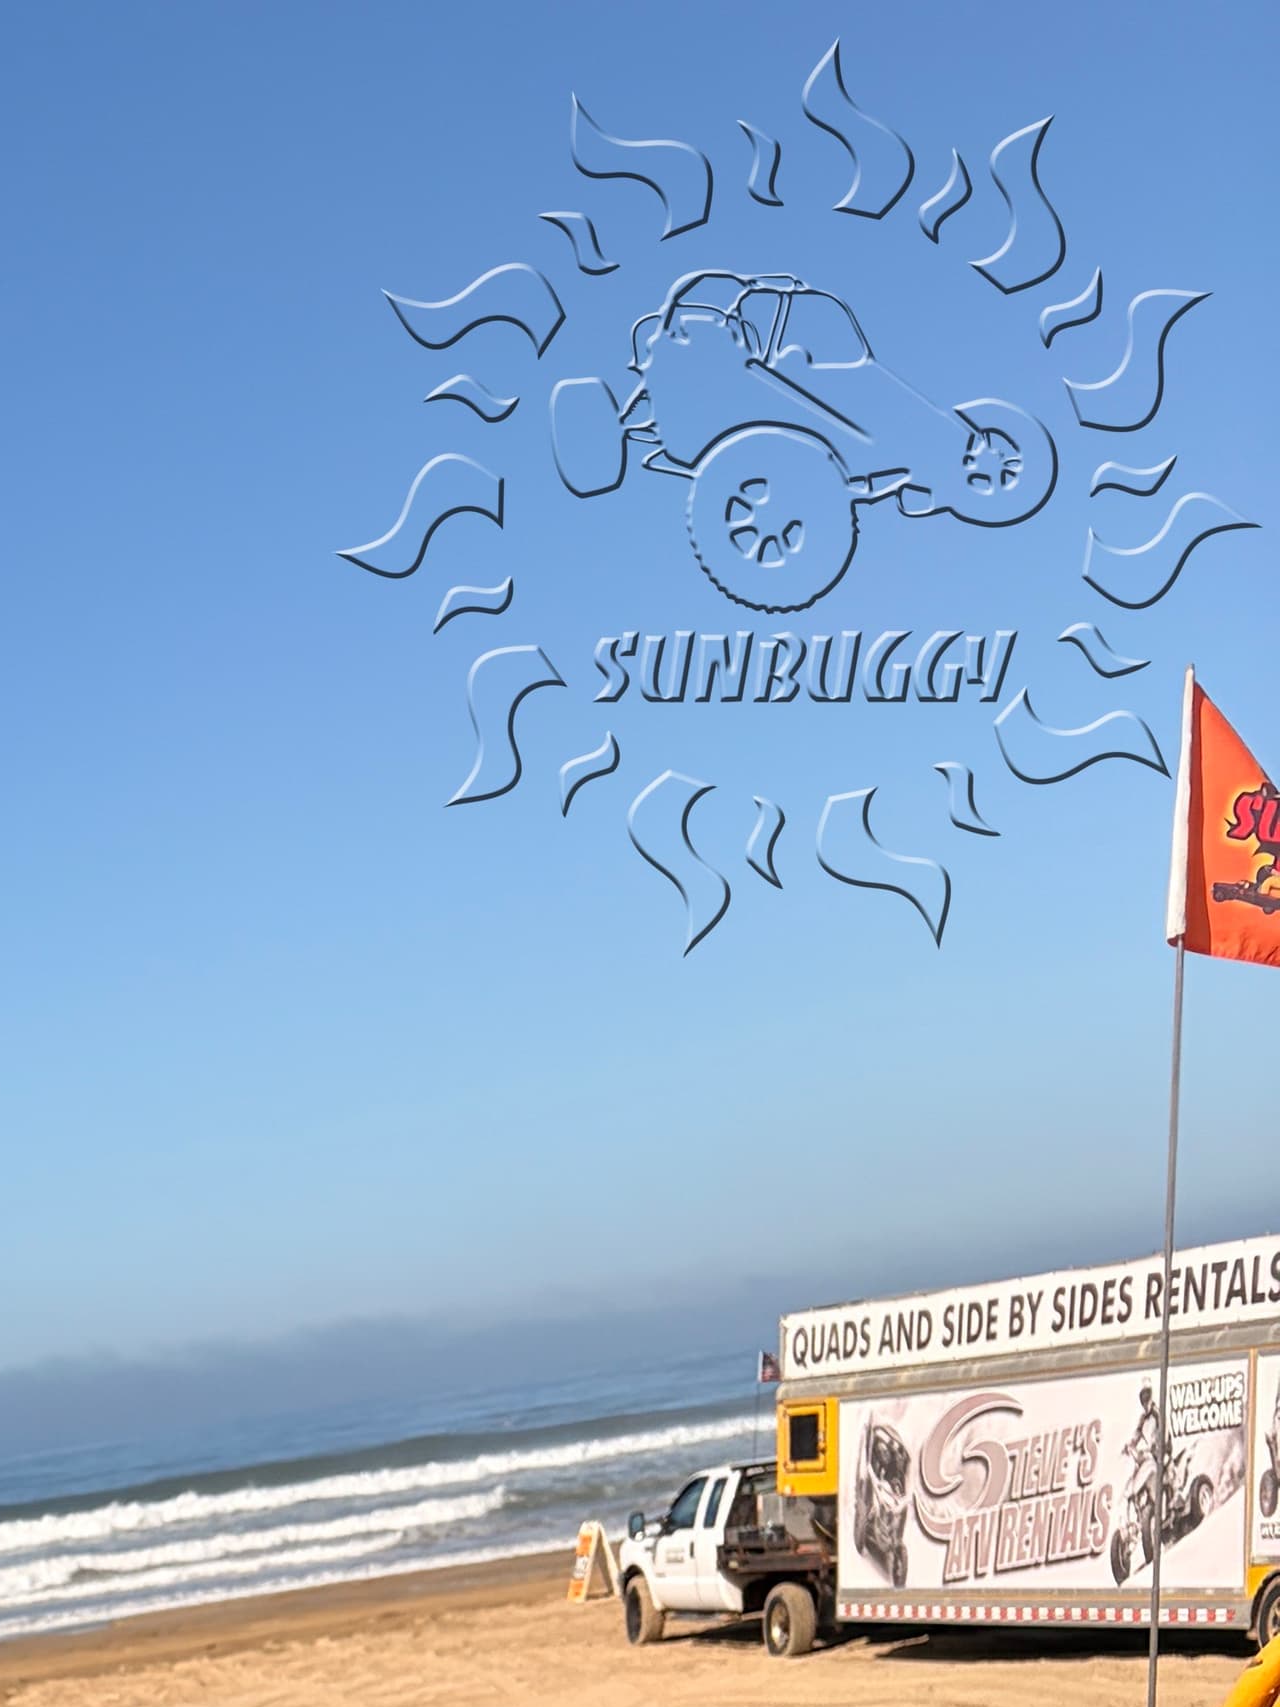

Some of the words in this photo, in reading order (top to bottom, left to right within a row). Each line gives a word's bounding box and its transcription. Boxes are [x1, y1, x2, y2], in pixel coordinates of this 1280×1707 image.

[792, 1317, 871, 1369] QUADS
[878, 1309, 933, 1356] AND
[941, 1298, 1000, 1348] SIDE
[1008, 1289, 1044, 1338] BY
[1051, 1275, 1133, 1334] SIDES
[1144, 1251, 1280, 1320] RENTALS
[1169, 1372, 1244, 1410] WALK-UPS
[1170, 1400, 1243, 1438] WELCOME
[943, 1507, 1000, 1584] ATV
[994, 1483, 1114, 1574] RENTALS
